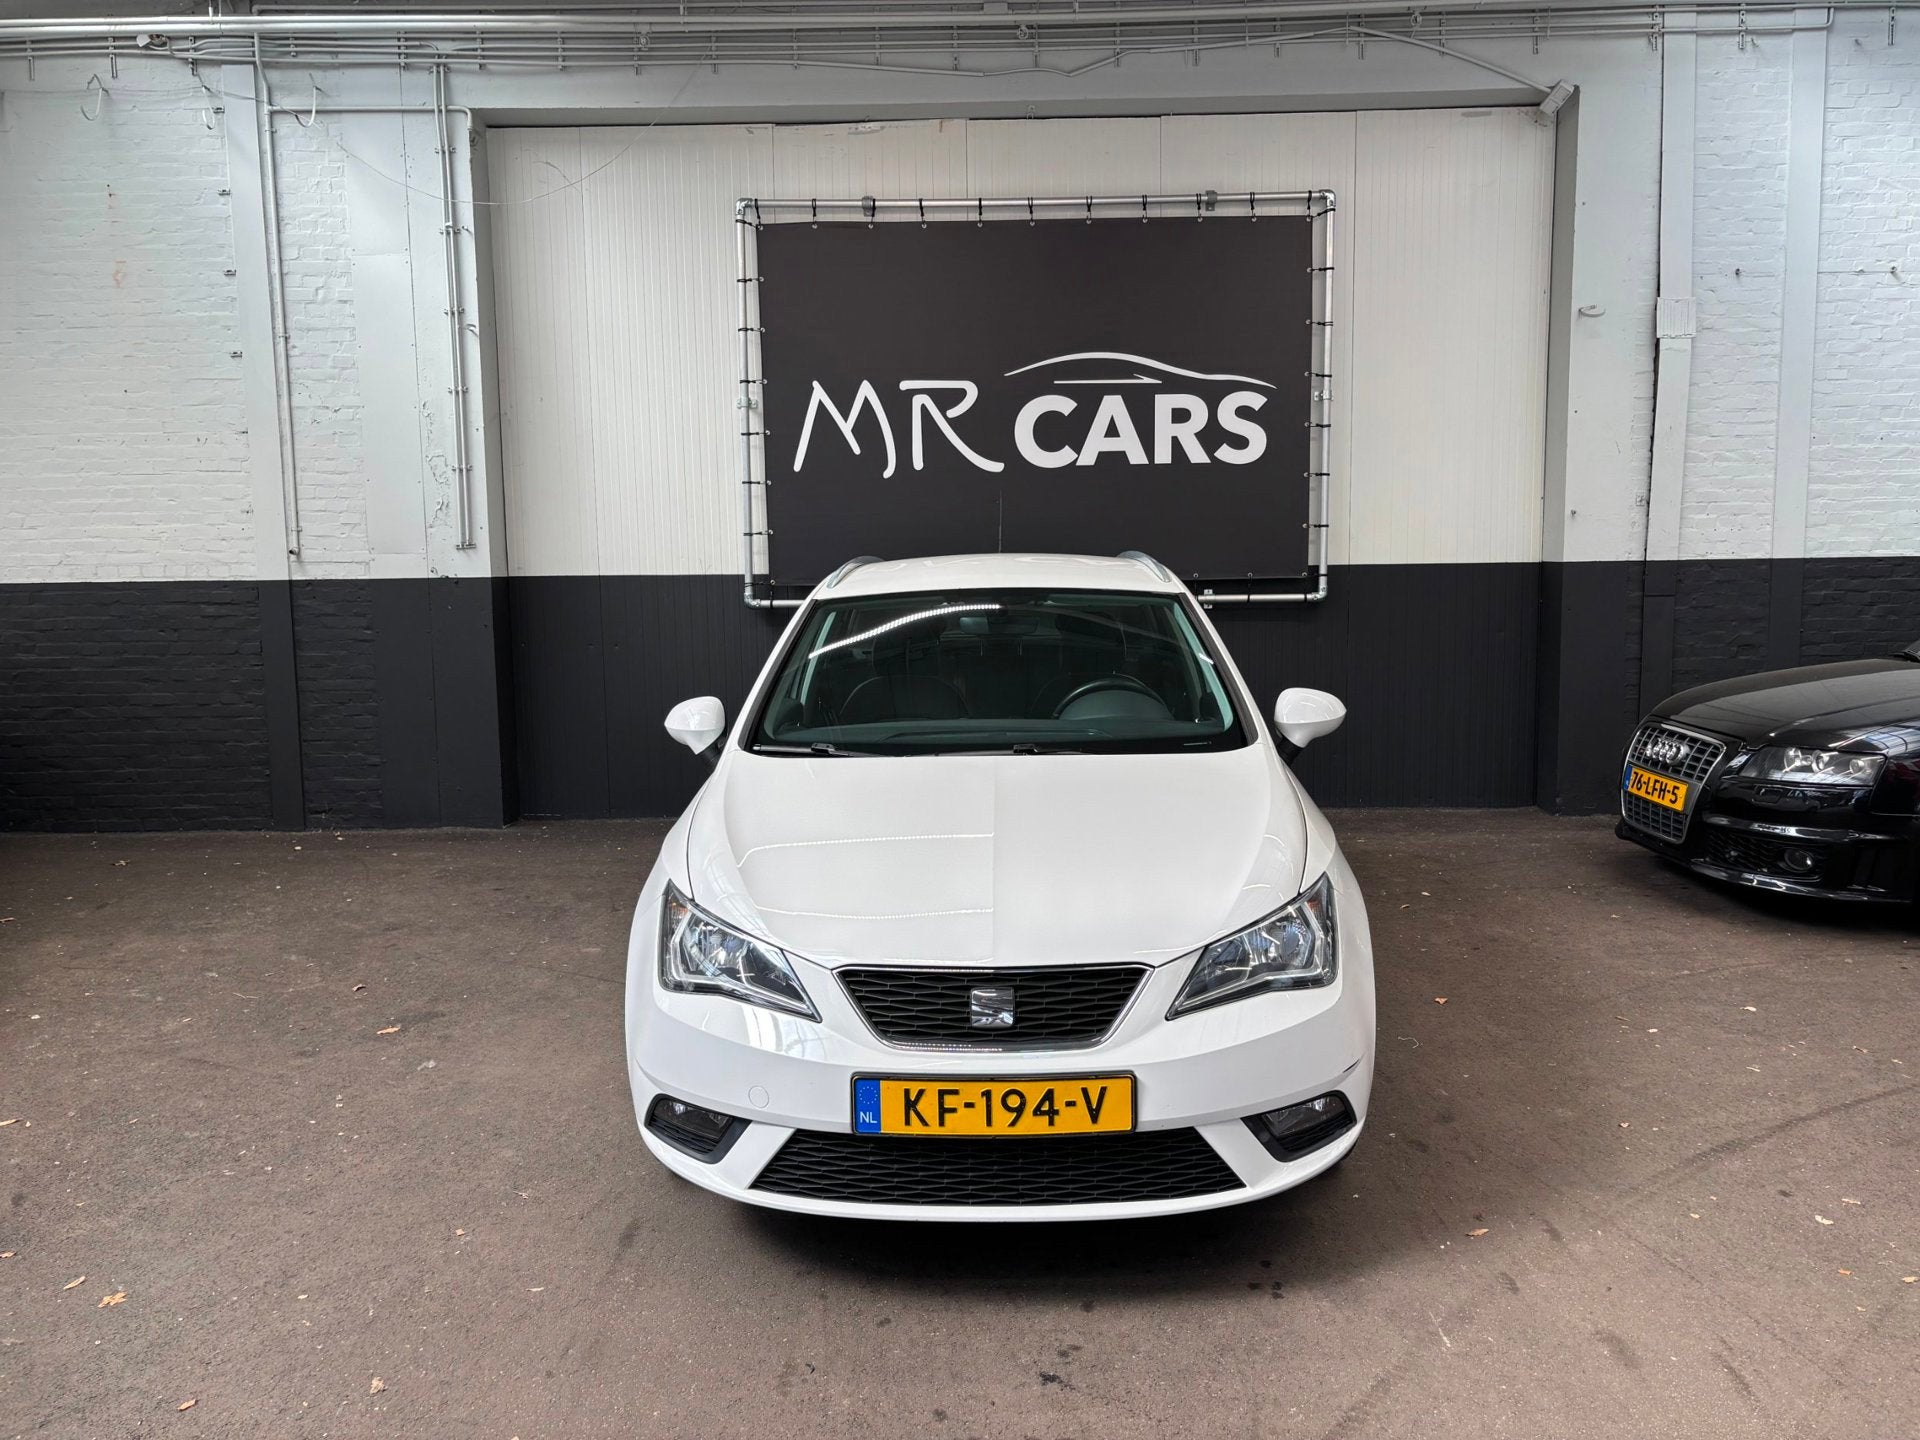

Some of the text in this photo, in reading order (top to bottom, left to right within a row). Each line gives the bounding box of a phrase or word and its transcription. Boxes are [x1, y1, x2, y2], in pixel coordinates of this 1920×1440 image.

[794, 379, 1268, 479] MR CARS
[1631, 771, 1680, 804] 76-LFH-5
[860, 1112, 877, 1124] NL
[903, 1086, 1107, 1127] KF-194-V
